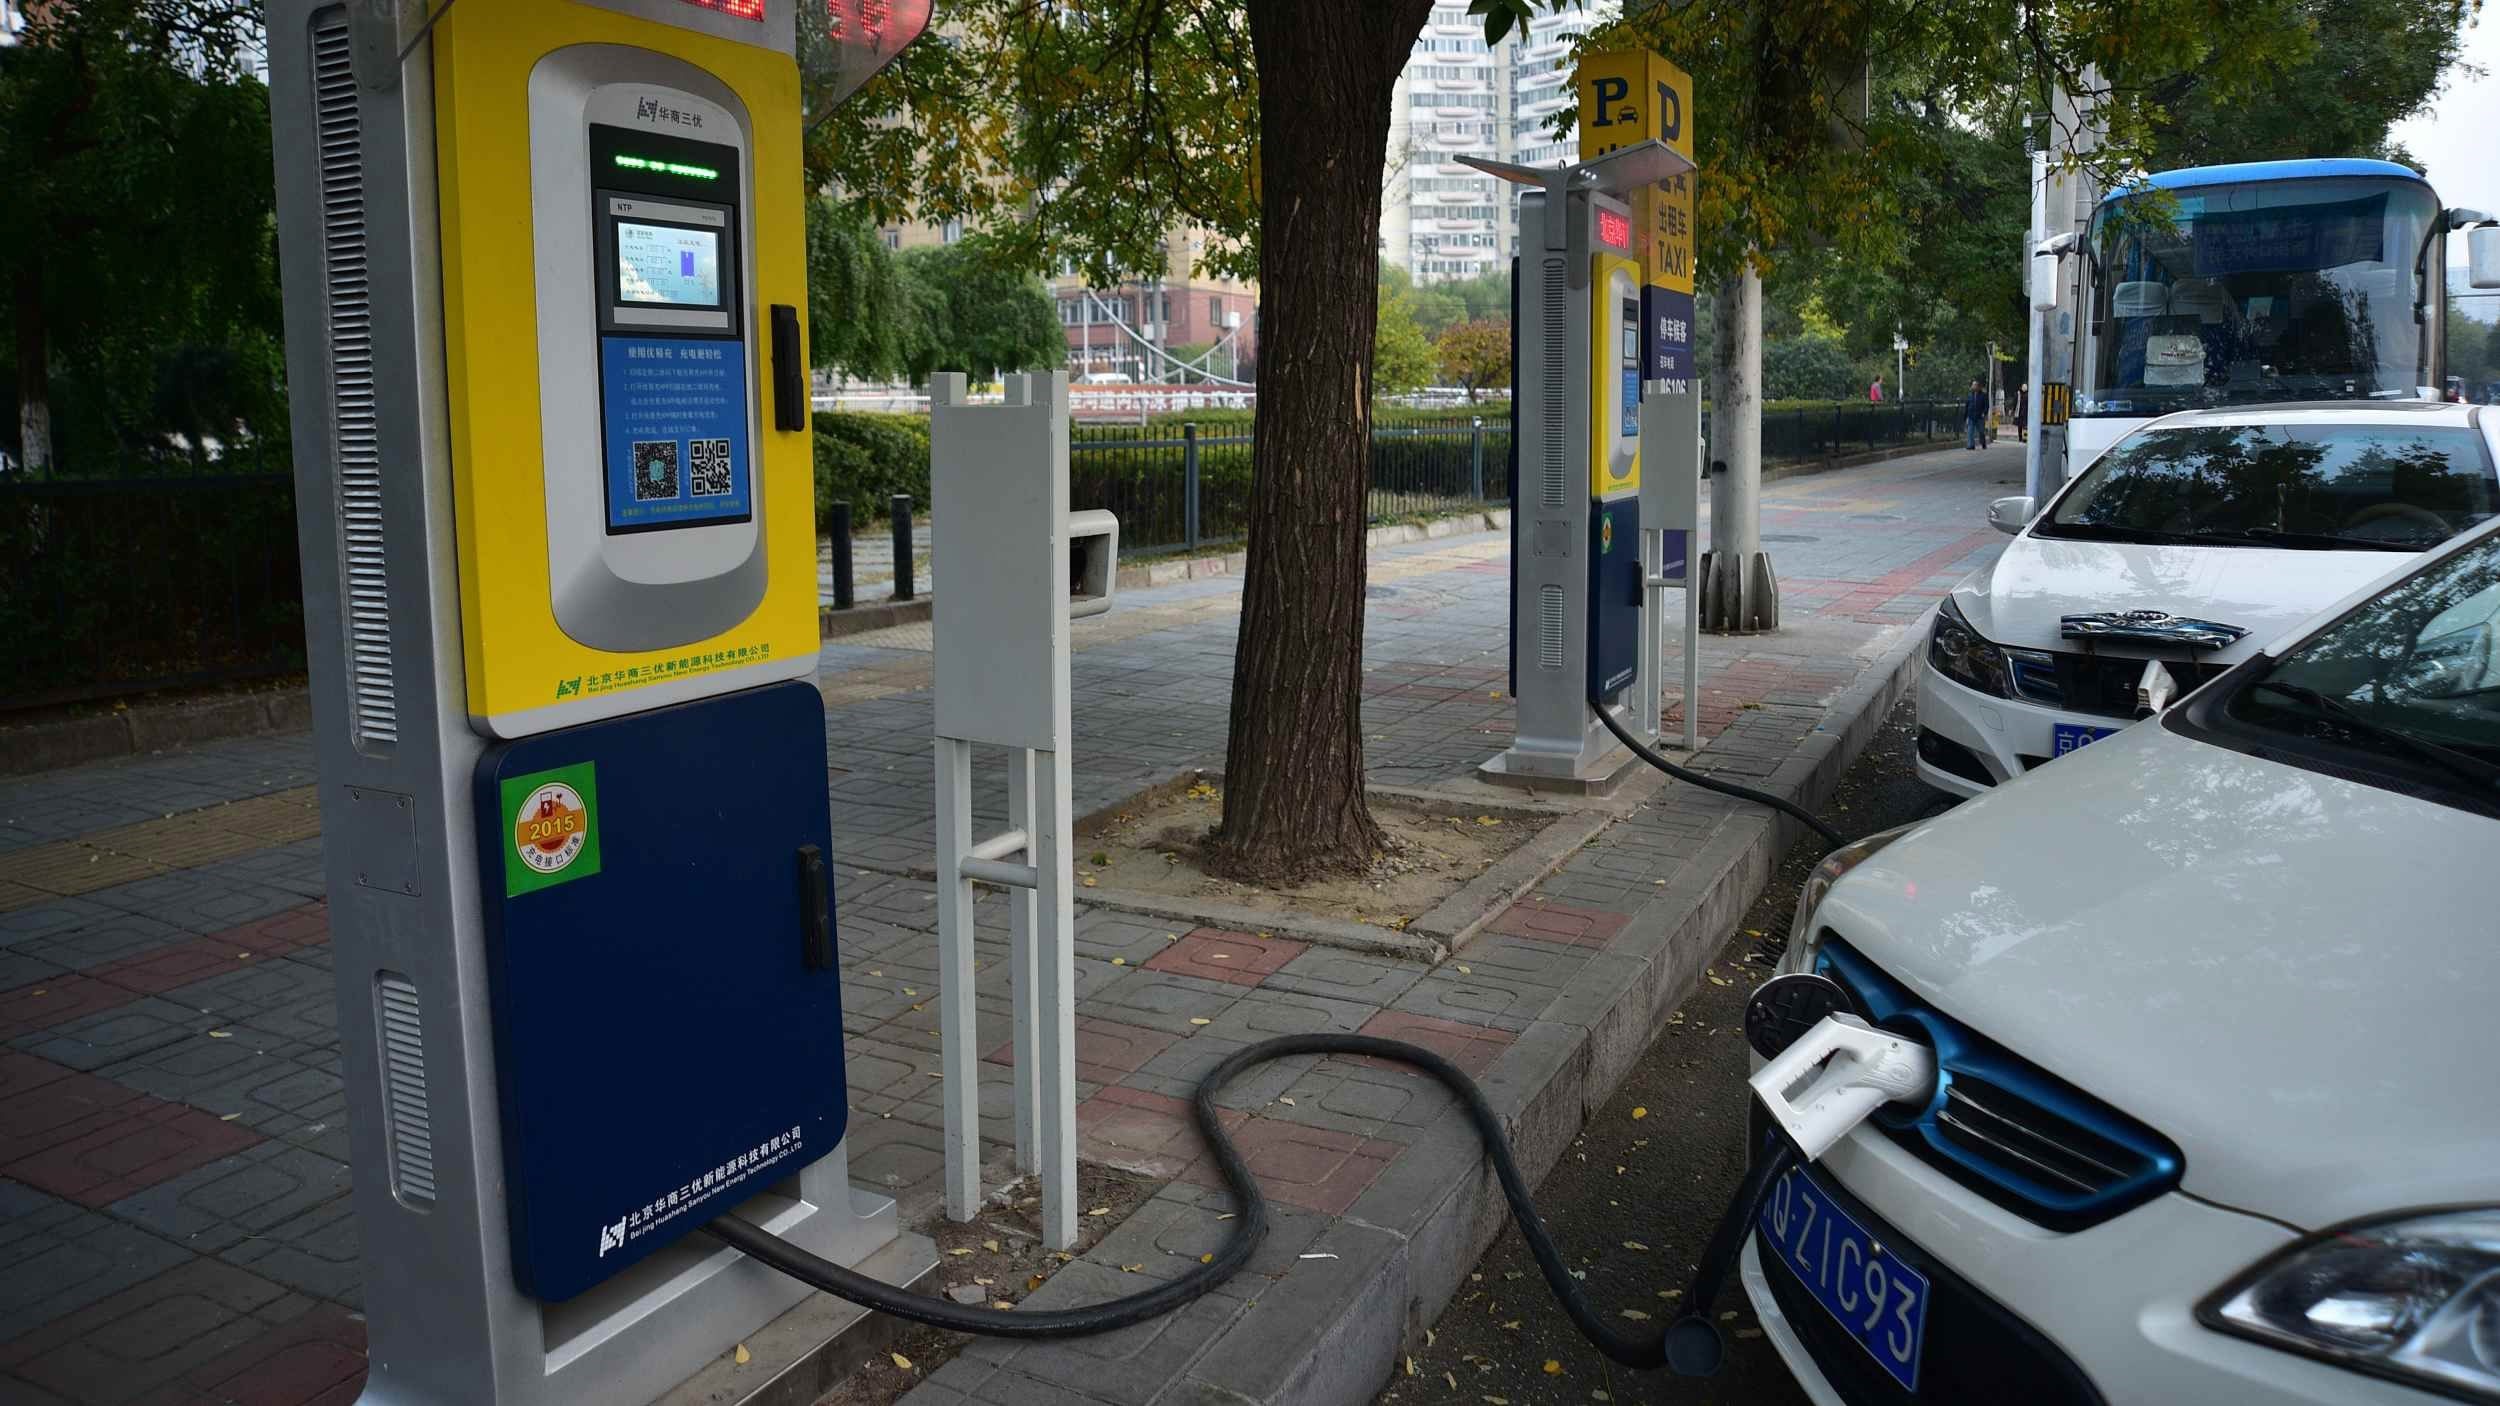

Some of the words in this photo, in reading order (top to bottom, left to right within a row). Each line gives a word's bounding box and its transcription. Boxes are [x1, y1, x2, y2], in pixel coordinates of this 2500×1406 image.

[659, 106, 703, 128] 华商三优
[1592, 77, 1628, 127] P
[617, 203, 632, 214] NTP
[1658, 200, 1687, 240] 出租车
[1658, 240, 1687, 279] TAXI
[587, 643, 770, 687] 北京华商三优新能源科技有限公司
[530, 815, 575, 840] 2015
[629, 1126, 802, 1227] 北京华商三优新能源科技有限公司
[655, 1204, 688, 1226] Huashang
[688, 1190, 712, 1209] Sanyou
[712, 1182, 725, 1195] New
[726, 1171, 746, 1188] Energy
[747, 1156, 778, 1175] Technology
